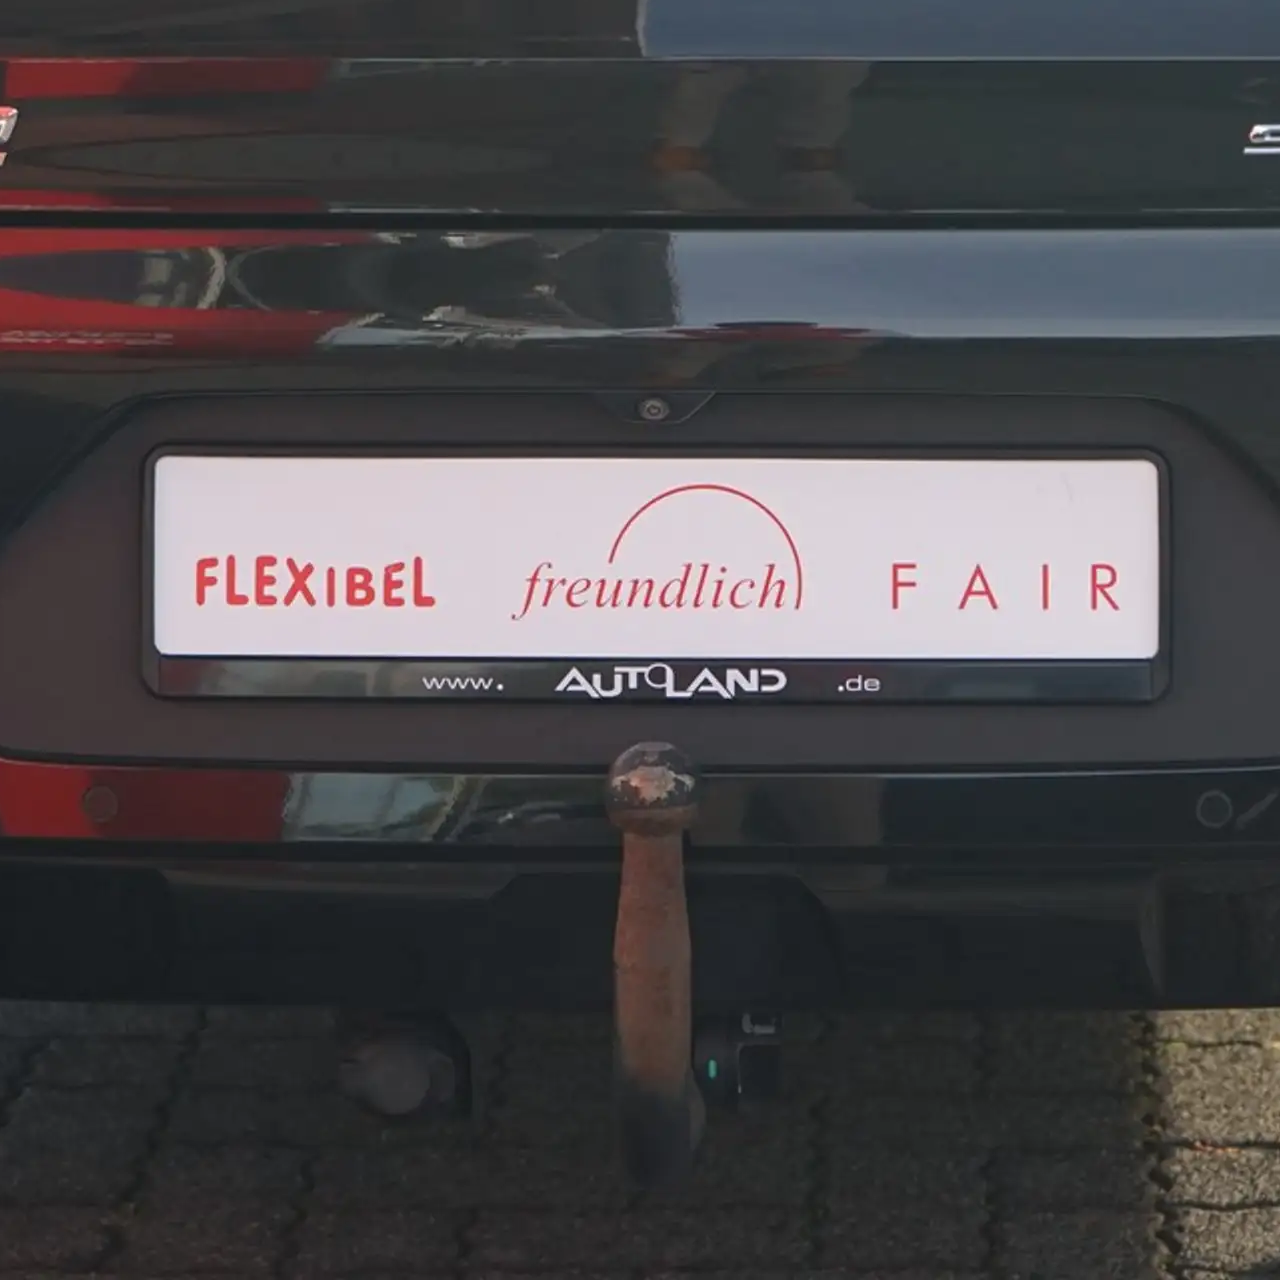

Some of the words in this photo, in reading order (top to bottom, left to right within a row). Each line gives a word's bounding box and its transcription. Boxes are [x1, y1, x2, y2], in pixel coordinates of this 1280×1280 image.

[195, 554, 437, 608] FLEXIBEL
[511, 562, 787, 621] freundlich
[891, 562, 1121, 611] FAIR
[422, 675, 505, 692] www.
[554, 663, 788, 699] AUTOLAND
[837, 674, 882, 693] .de
